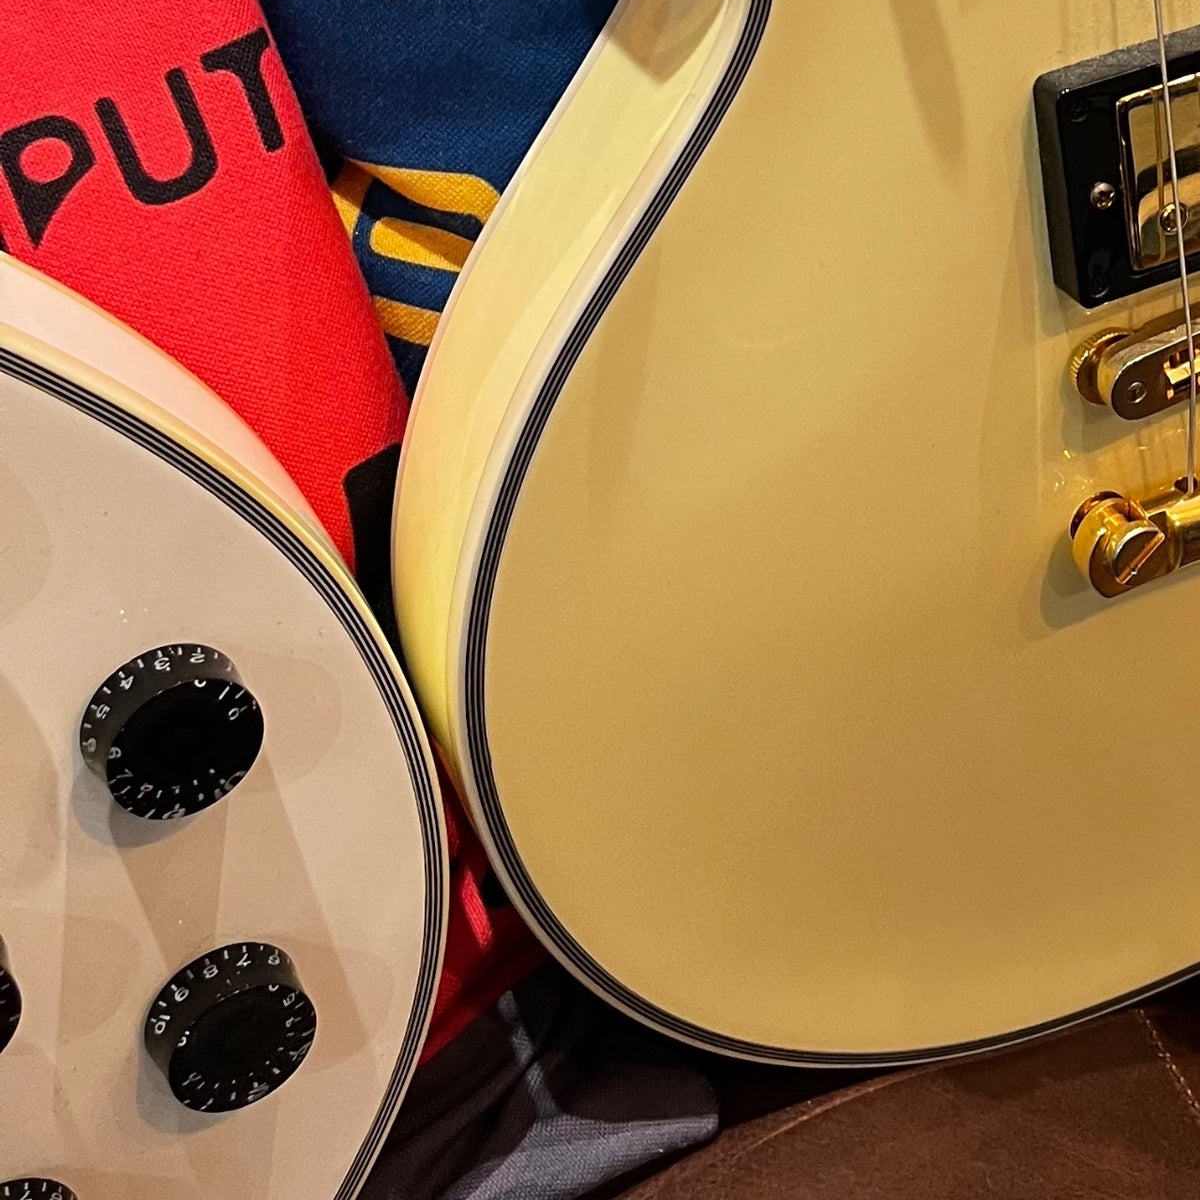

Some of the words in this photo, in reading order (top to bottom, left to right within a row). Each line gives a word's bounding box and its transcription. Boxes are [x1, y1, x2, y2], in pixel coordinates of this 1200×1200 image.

[190, 652, 205, 663] 2
[119, 675, 134, 690] 4
[95, 704, 110, 719] 5
[203, 964, 219, 979] 8
[174, 986, 189, 1002] 9
[153, 1014, 171, 1035] 10
